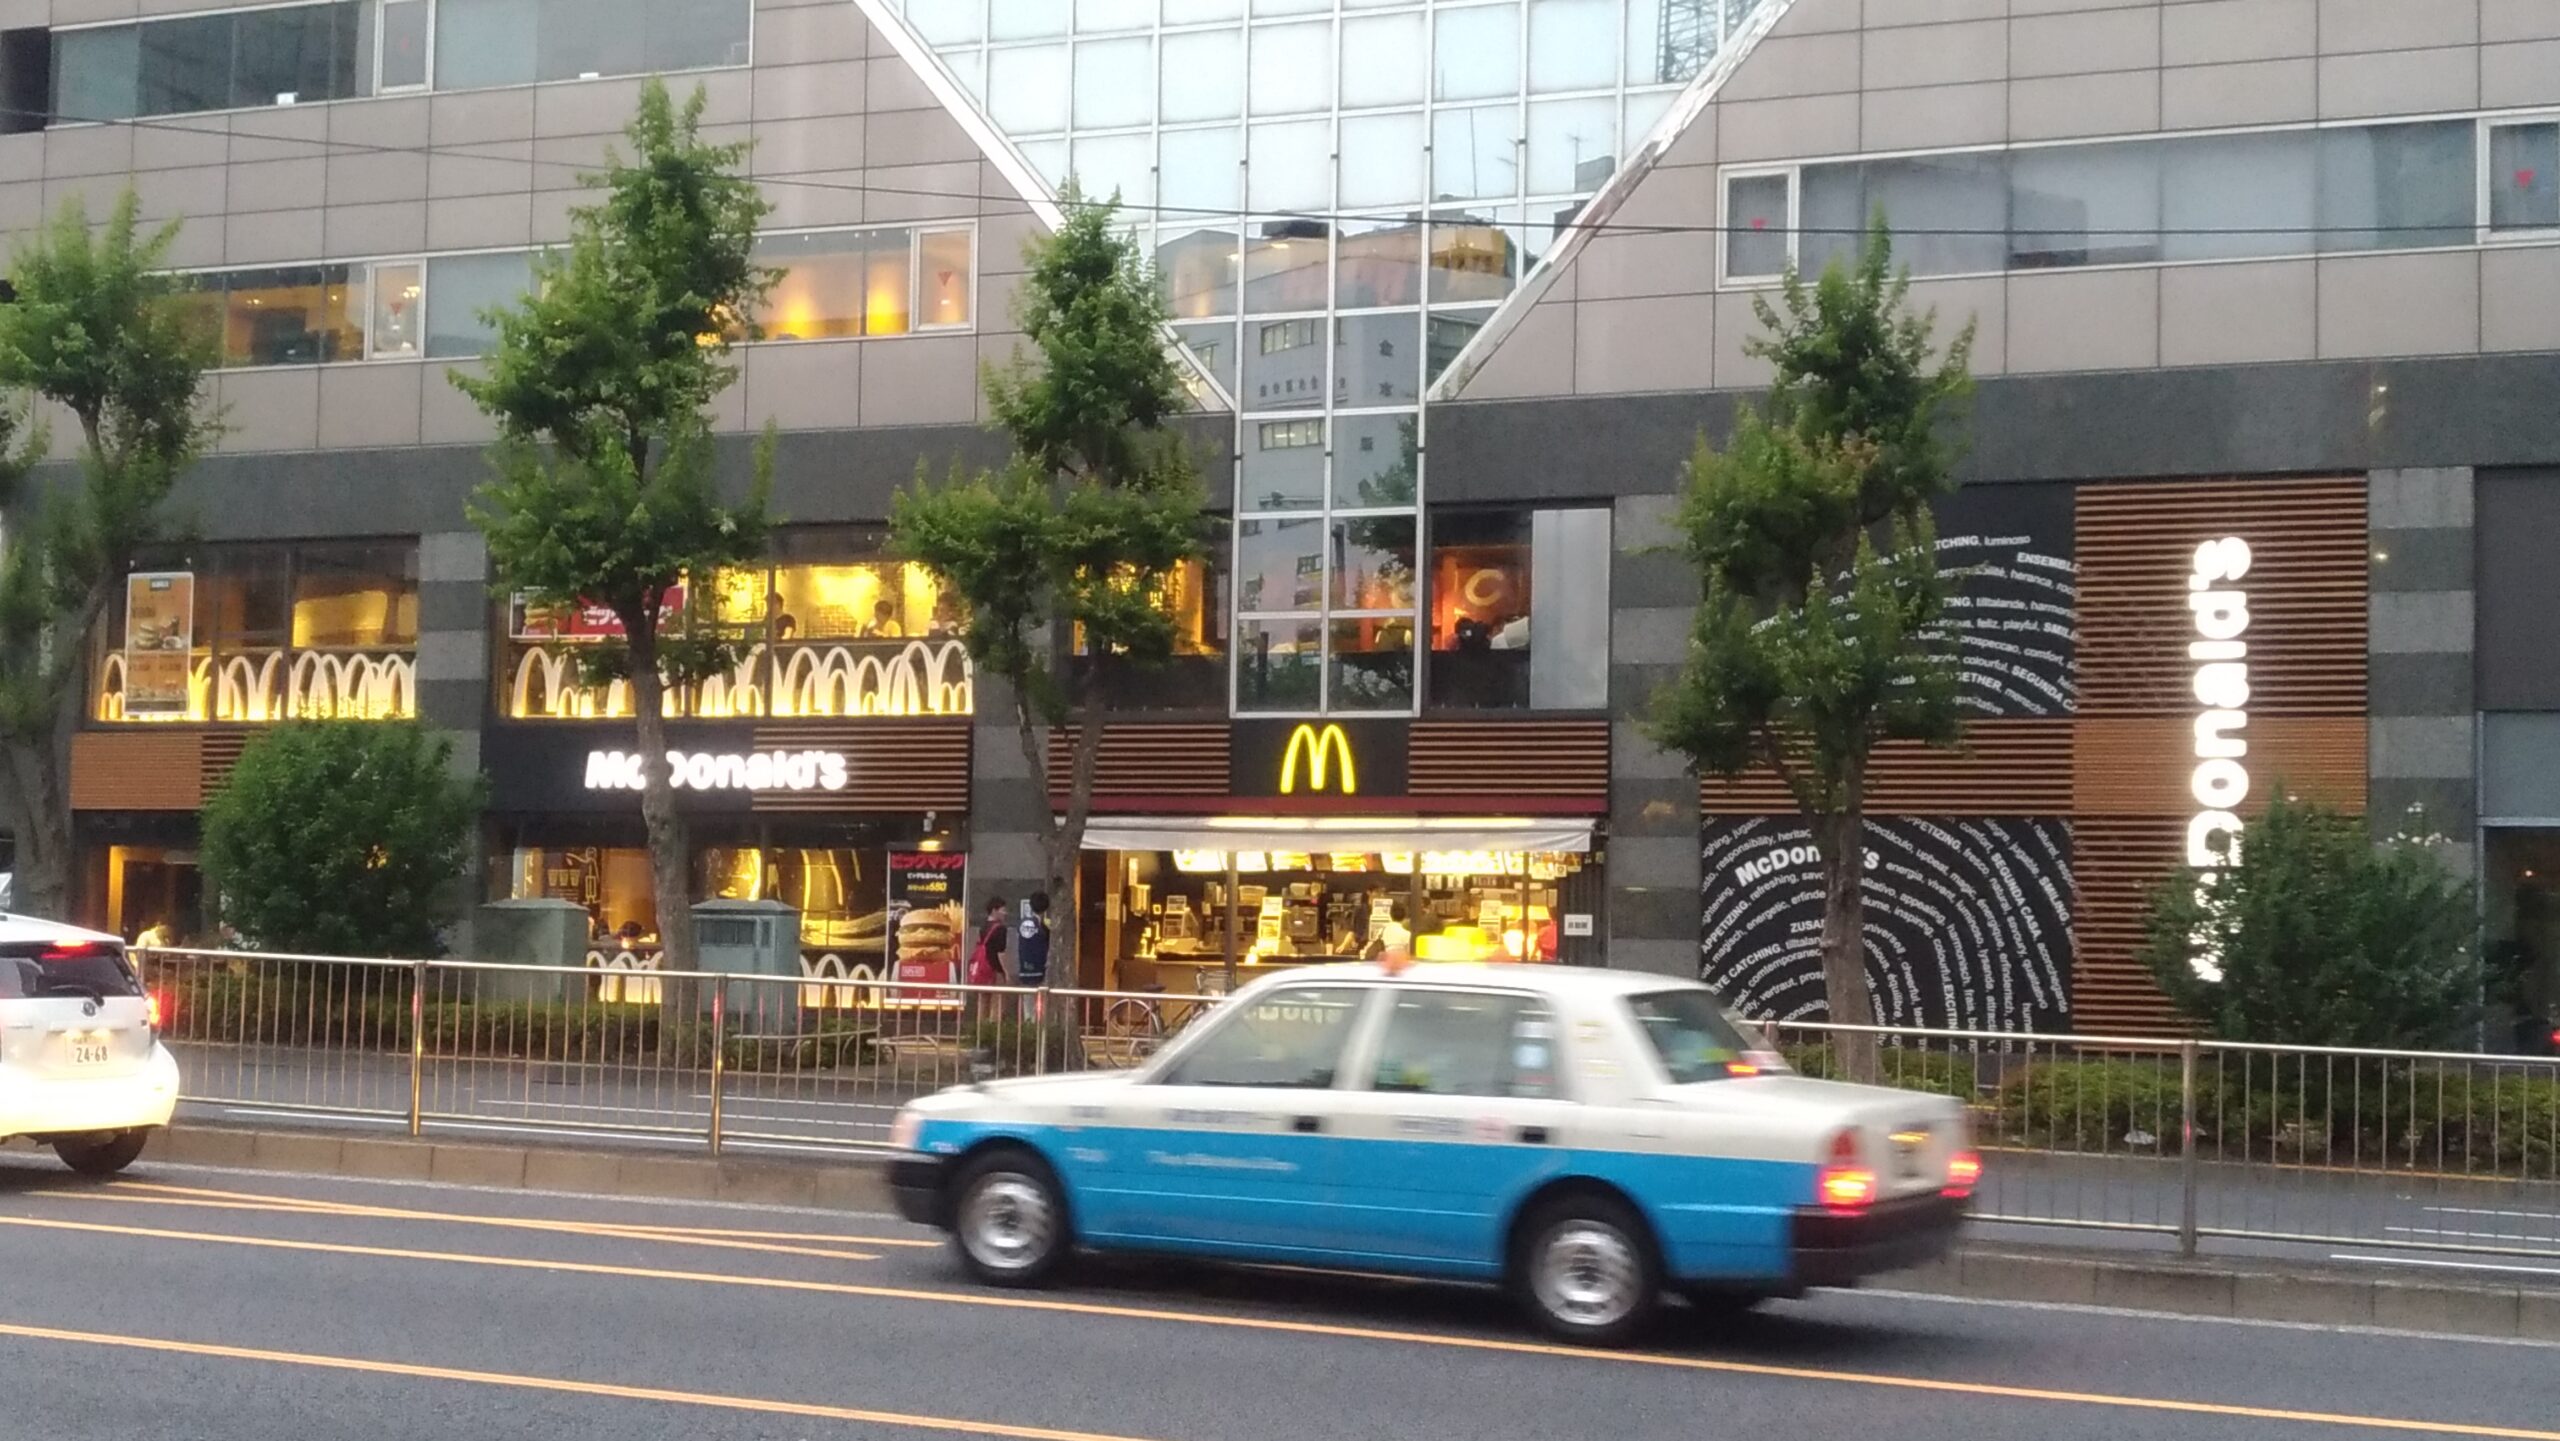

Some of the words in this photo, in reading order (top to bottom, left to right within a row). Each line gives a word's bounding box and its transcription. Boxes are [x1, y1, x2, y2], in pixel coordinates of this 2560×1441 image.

[2011, 665, 2064, 703] SEGUNDA
[2188, 536, 2252, 983] Donald's
[1716, 835, 1777, 872] responsibility,
[1734, 845, 1881, 887] McDon's
[1991, 853, 2027, 907] SEGUNDA
[2039, 876, 2070, 926] SMILING,
[1701, 900, 1752, 954] APPETIZING,
[1749, 869, 1800, 902] refreshing,
[1712, 929, 1748, 964] magisch,
[1746, 900, 1791, 931] energetic,
[1790, 888, 1827, 906] erfinde
[1943, 984, 1960, 1032] EXCITIN
[1728, 943, 1785, 978] CATCHING,
[1862, 937, 1891, 974] onious,
[1760, 977, 1798, 1003] vertraut,
